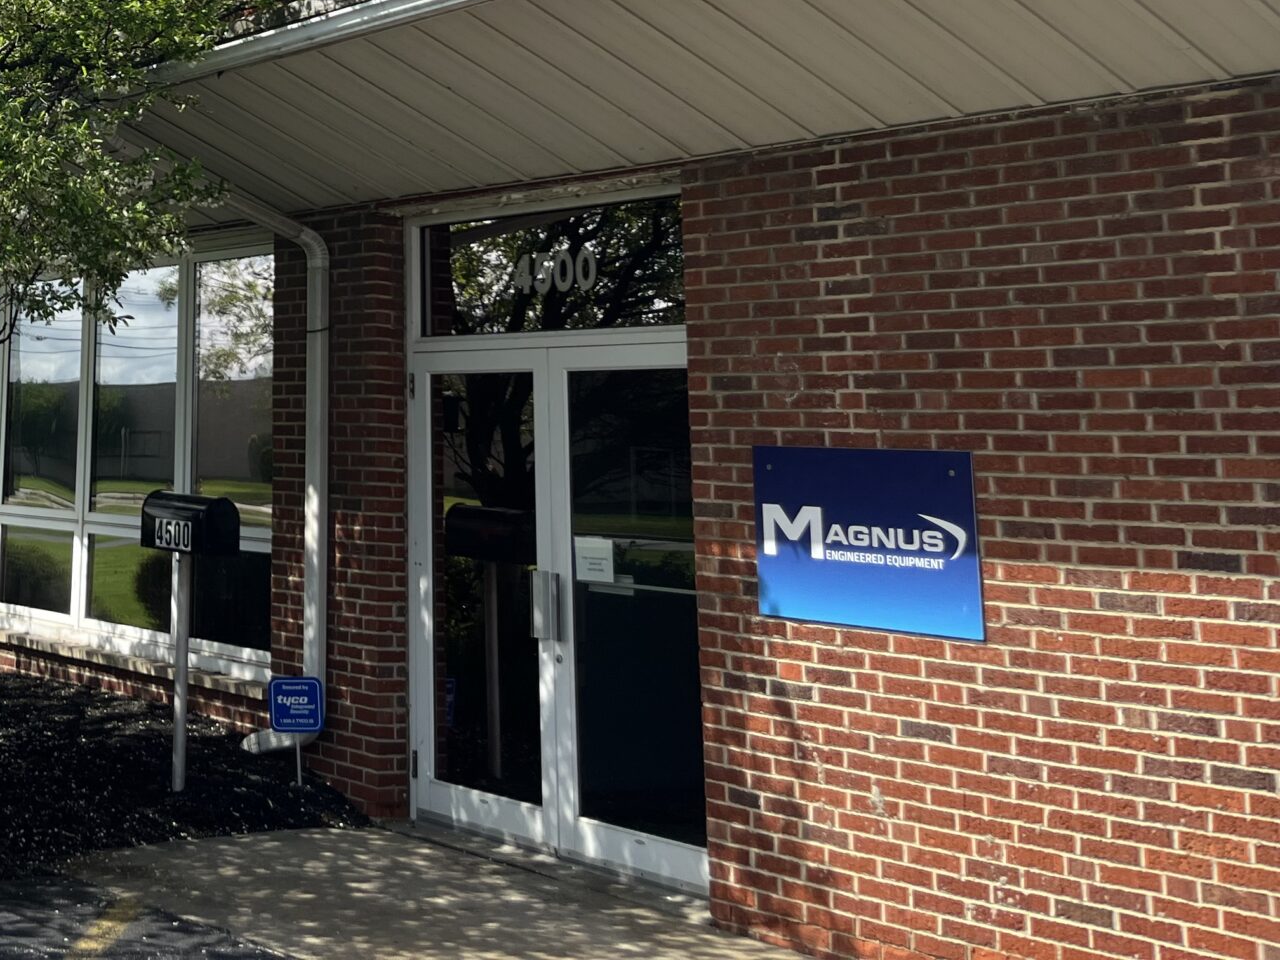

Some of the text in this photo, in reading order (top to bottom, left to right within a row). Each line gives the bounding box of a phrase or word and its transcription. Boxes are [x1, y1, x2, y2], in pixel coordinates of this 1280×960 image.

[515, 247, 596, 294] 4500
[156, 520, 190, 548] 4500
[762, 504, 944, 559] MAGNUS
[826, 550, 944, 569] ENGINEERED EQUIPMENT
[277, 695, 308, 706] tyco
